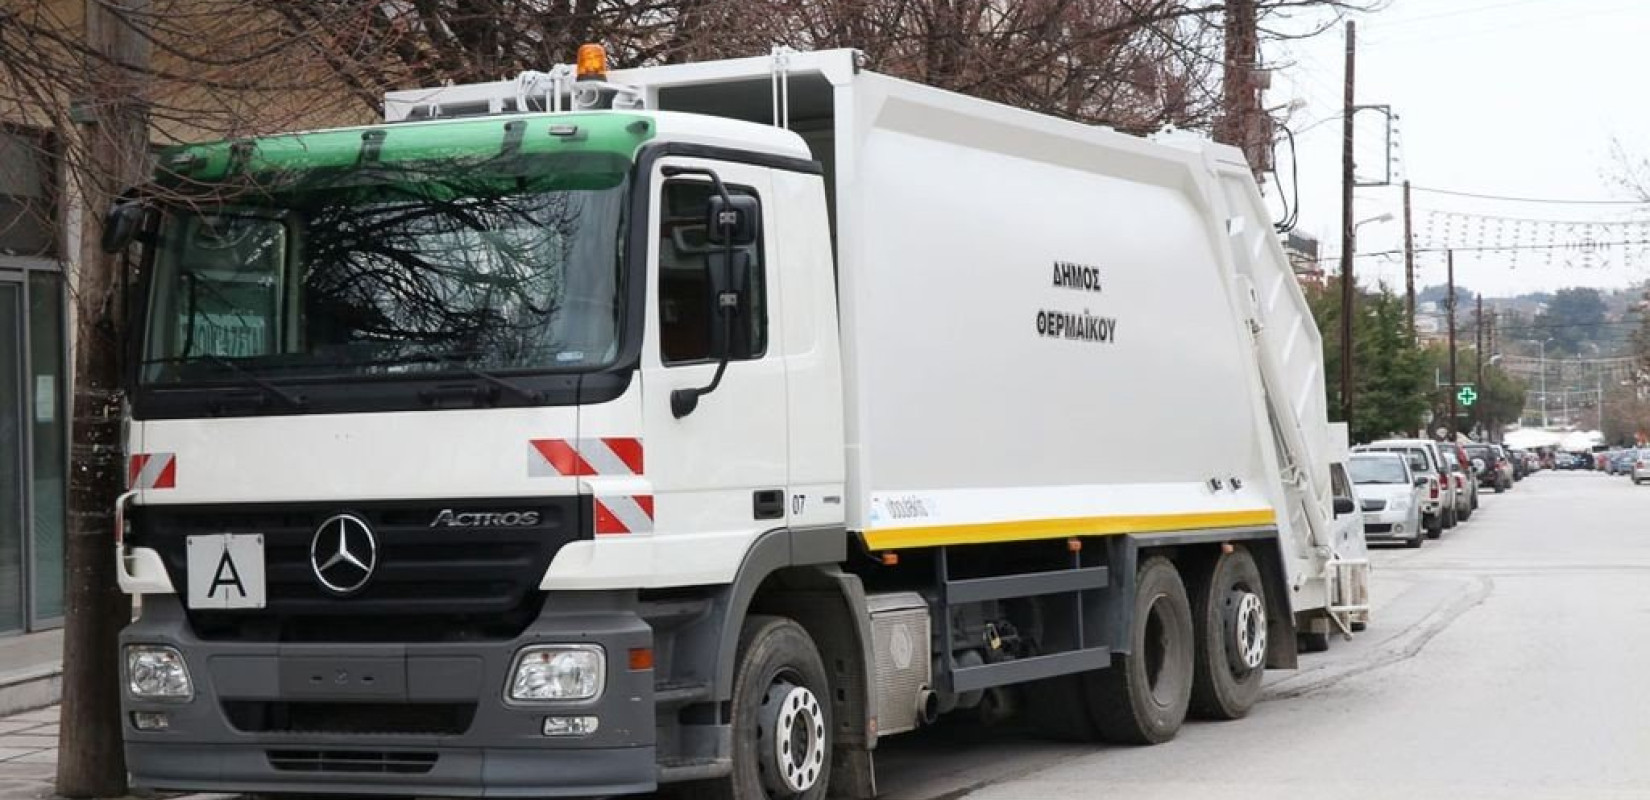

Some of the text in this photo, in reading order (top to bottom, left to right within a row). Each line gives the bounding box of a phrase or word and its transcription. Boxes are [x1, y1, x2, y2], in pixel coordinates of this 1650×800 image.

[1053, 260, 1101, 292] ΔΗΜΟΣ
[1036, 308, 1116, 343] ΘΕΡΜΑΪΚΟΥ
[430, 508, 540, 528] ACTROS
[792, 494, 805, 514] 07
[207, 546, 246, 598] A
